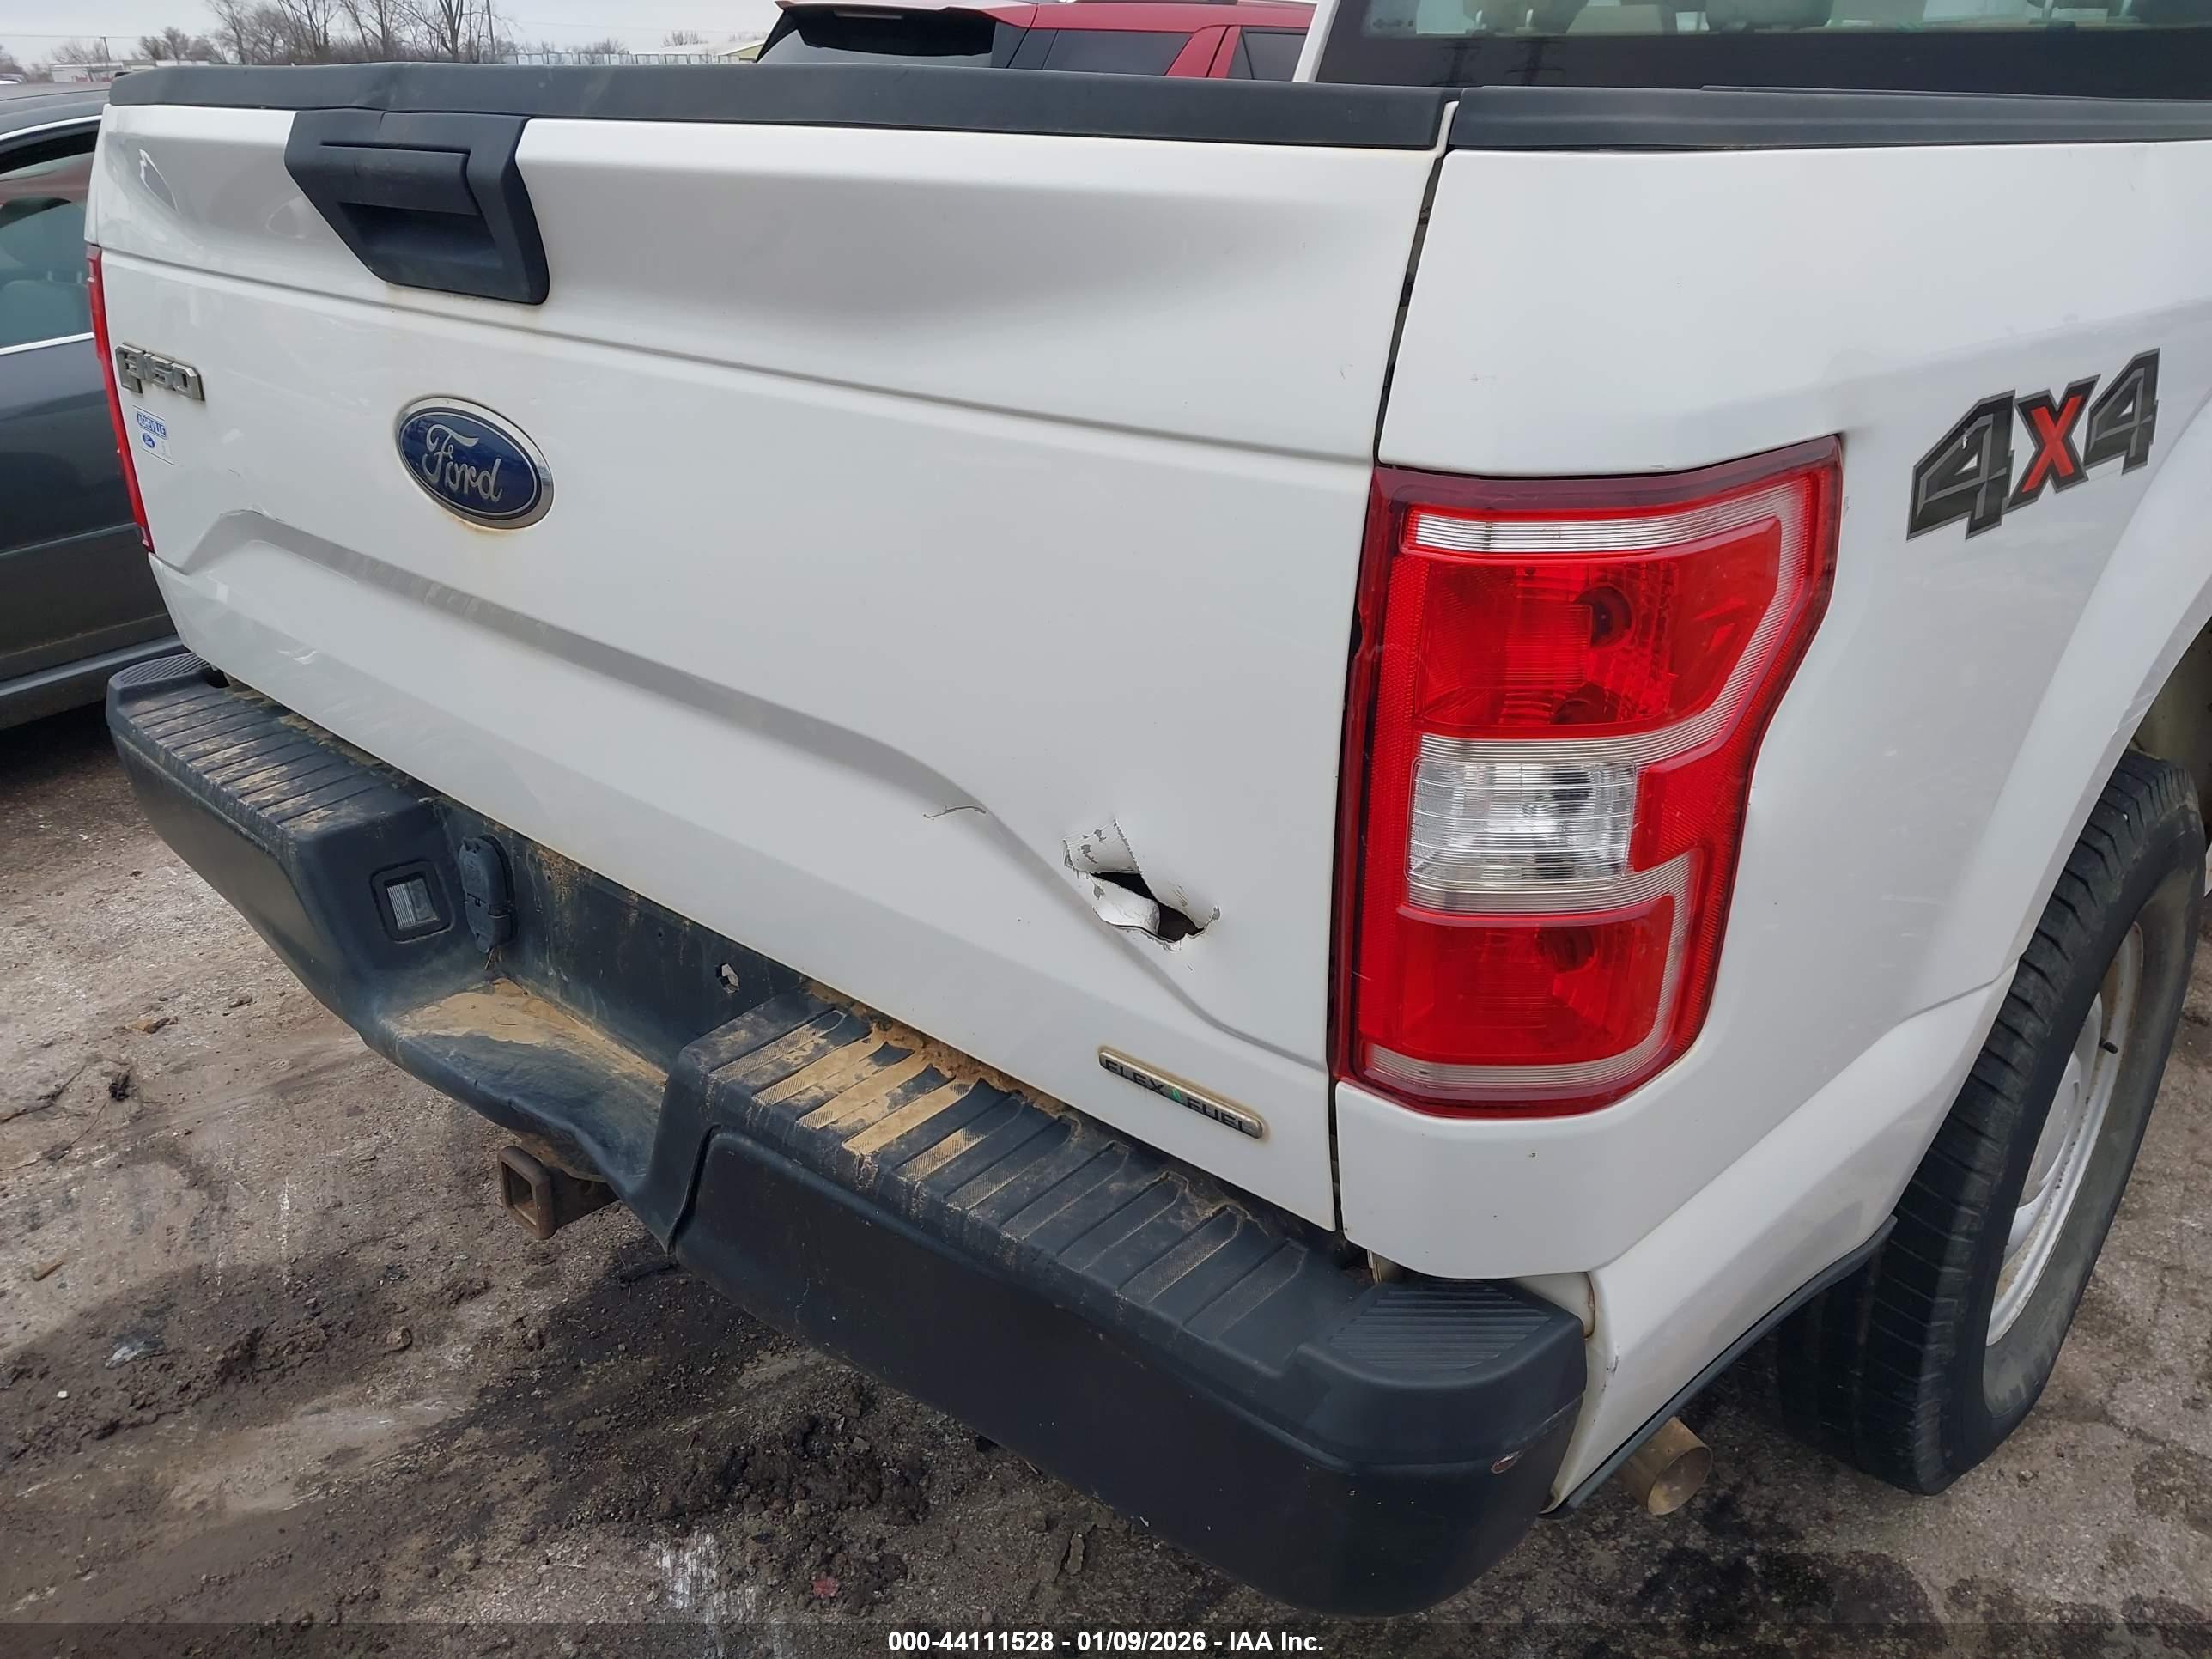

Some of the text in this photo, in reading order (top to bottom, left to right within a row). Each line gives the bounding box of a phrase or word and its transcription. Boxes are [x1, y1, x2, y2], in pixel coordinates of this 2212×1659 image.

[422, 424, 503, 503] Ford
[1104, 1058, 1252, 1133] FLEX FUEL
